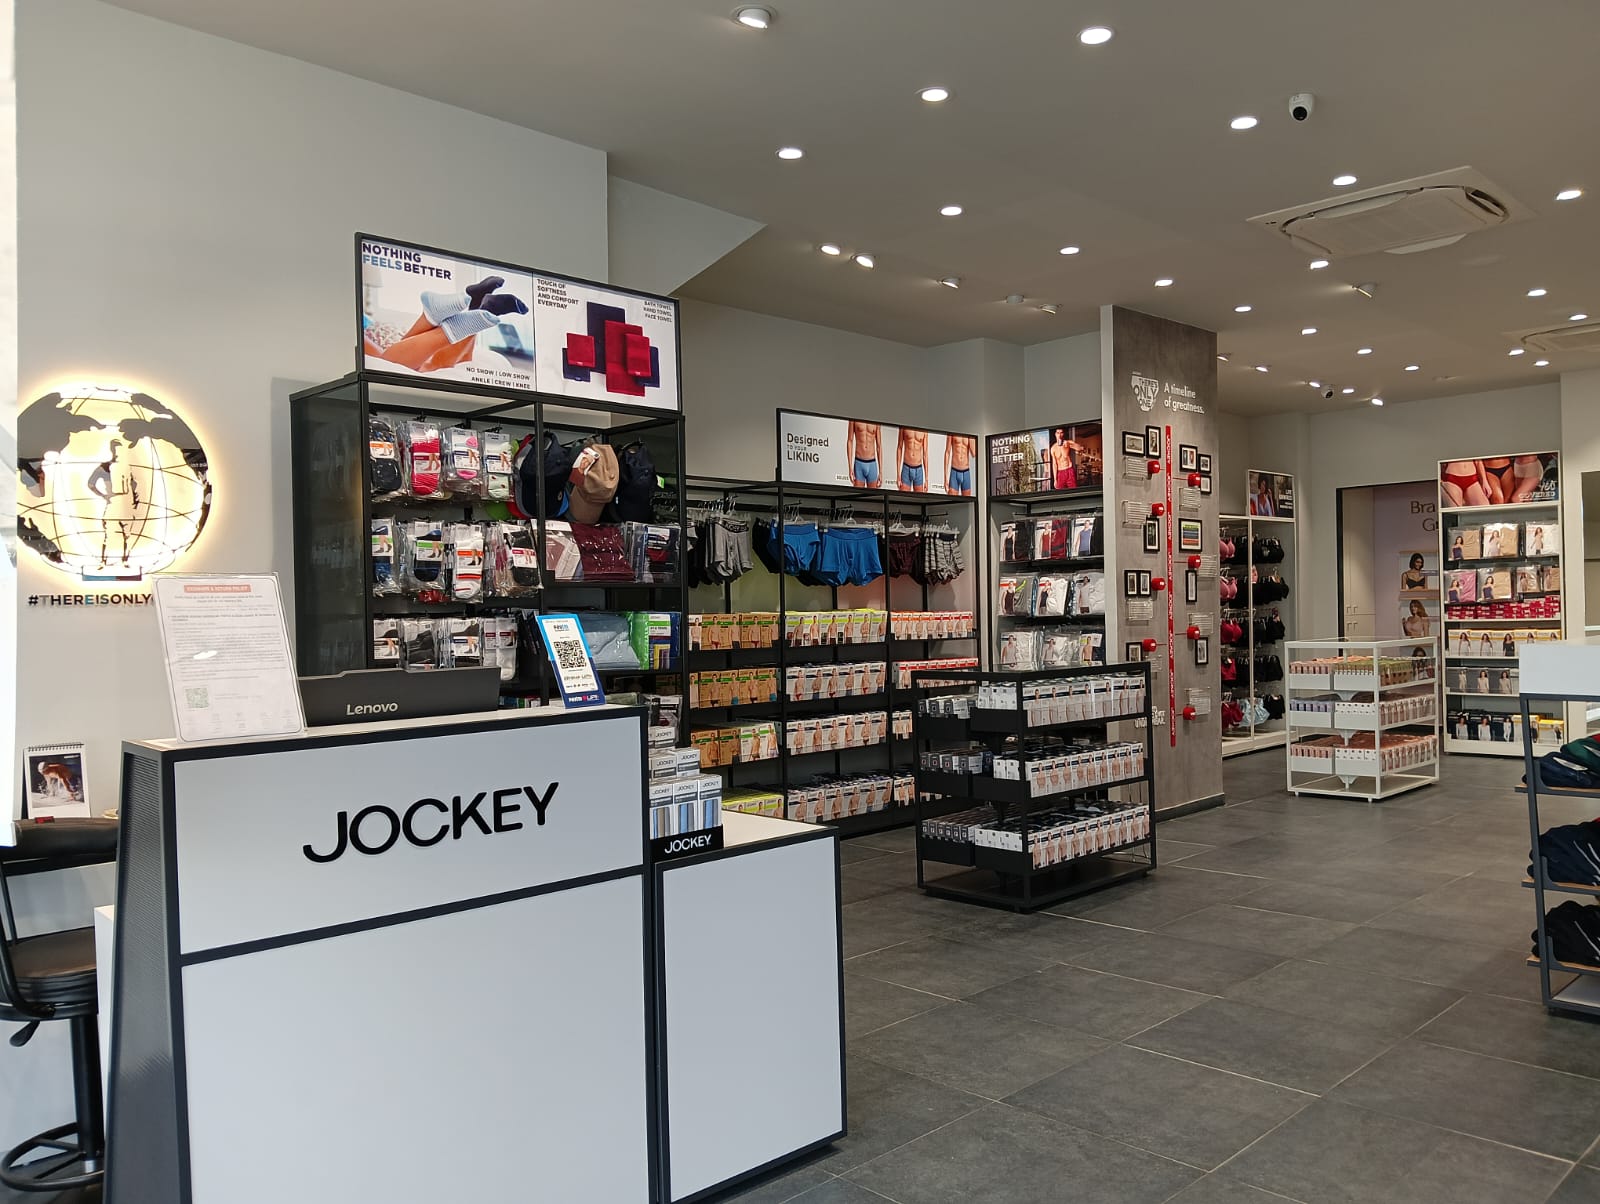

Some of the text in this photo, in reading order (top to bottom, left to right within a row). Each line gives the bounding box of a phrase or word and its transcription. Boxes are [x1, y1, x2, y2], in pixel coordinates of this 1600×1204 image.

[362, 243, 422, 262] NOTHING
[362, 254, 451, 280] FEELS BETTER
[537, 279, 557, 287] TOUCH
[537, 286, 567, 296] SOFTNESS
[538, 299, 567, 309] EVERYDAY
[551, 295, 578, 304] COMFORT
[1163, 382, 1170, 393] A
[1171, 383, 1196, 399] timeline
[1163, 396, 1171, 407] of
[787, 433, 829, 447] Designed
[992, 434, 1031, 447] NOTHING
[787, 450, 820, 463] LIKING
[992, 446, 1010, 456] FITS
[992, 452, 1024, 464] BETTER
[1411, 500, 1435, 514] Bra
[28, 594, 155, 606] #THEREISONLY
[346, 701, 399, 716] Lenovo
[681, 753, 698, 761] JOCKEY
[702, 780, 719, 788] JOCKEY
[302, 781, 560, 863] JOCKEY
[664, 833, 712, 854] JOCKEY
